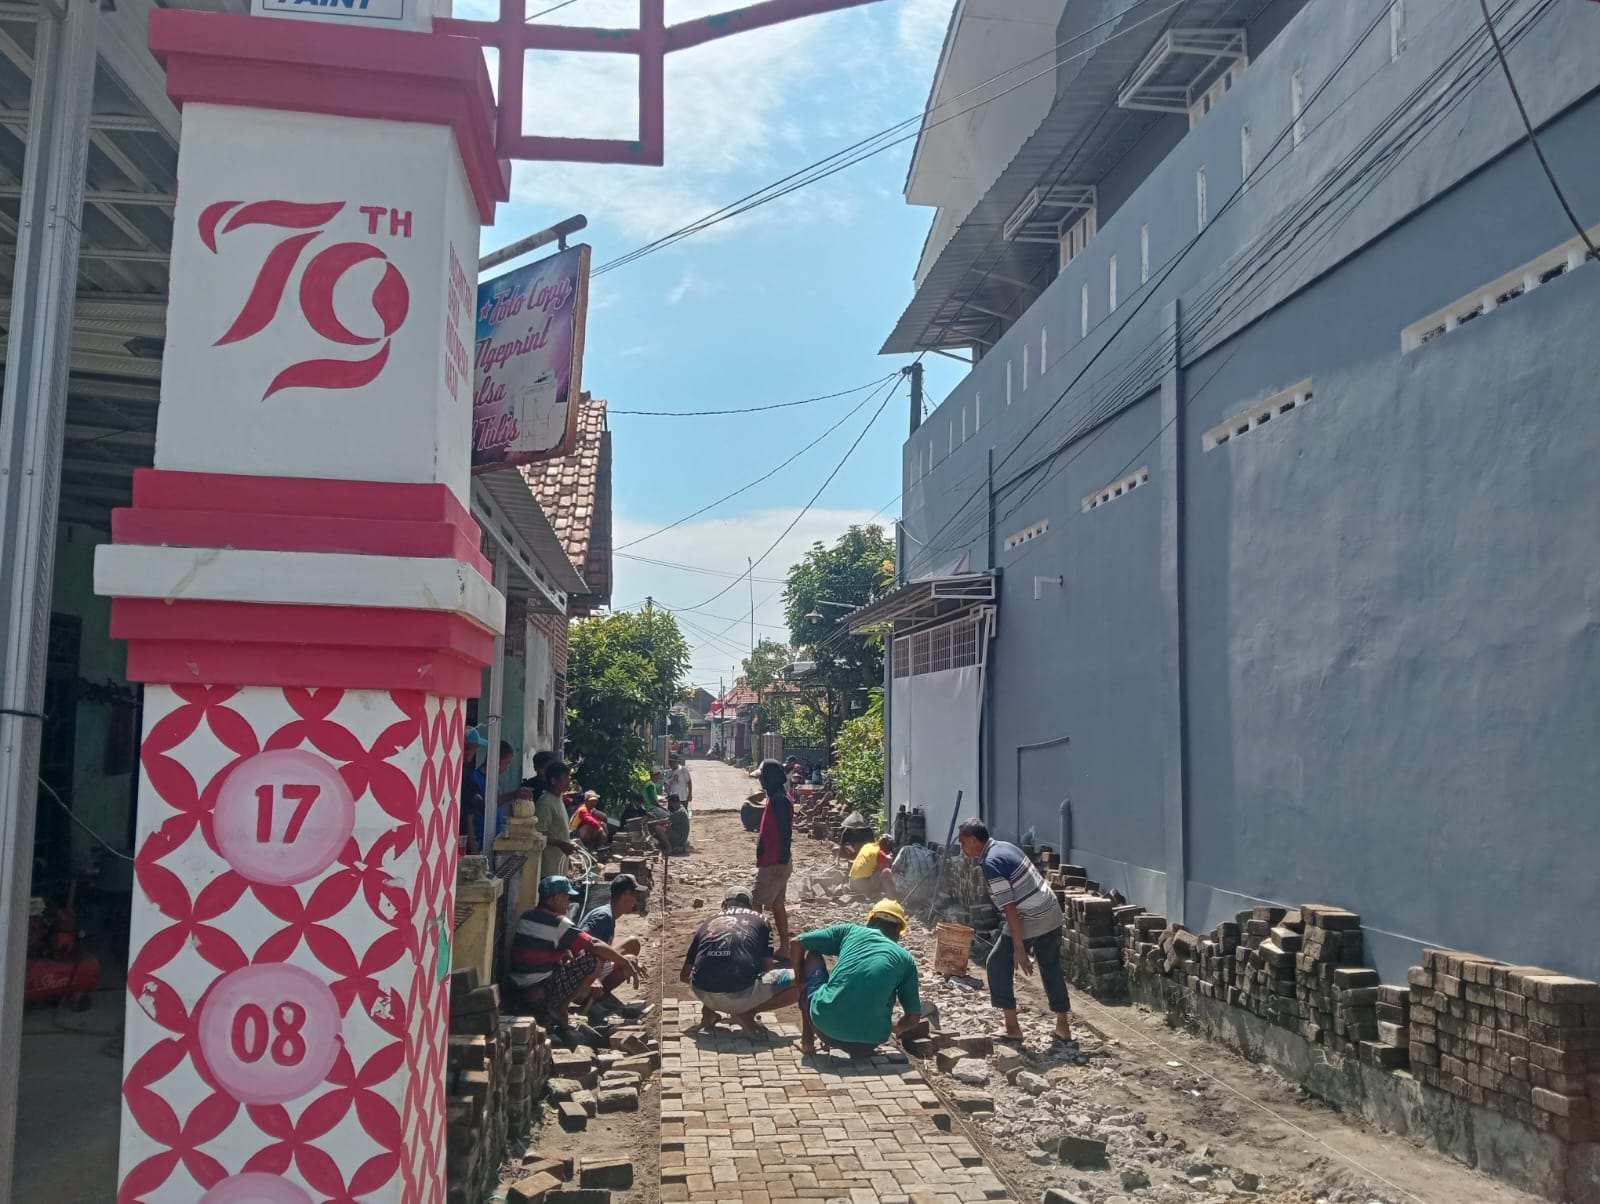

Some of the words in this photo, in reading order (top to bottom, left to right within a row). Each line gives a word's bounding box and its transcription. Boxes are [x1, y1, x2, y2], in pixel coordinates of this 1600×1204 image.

[197, 200, 410, 401] 79
[359, 206, 412, 238] TH
[489, 286, 525, 325] Foto
[527, 277, 572, 310] Copy
[474, 317, 554, 373] Ngeprint
[473, 376, 507, 407] ulsa
[254, 784, 321, 844] 17
[230, 1001, 306, 1066] 08
